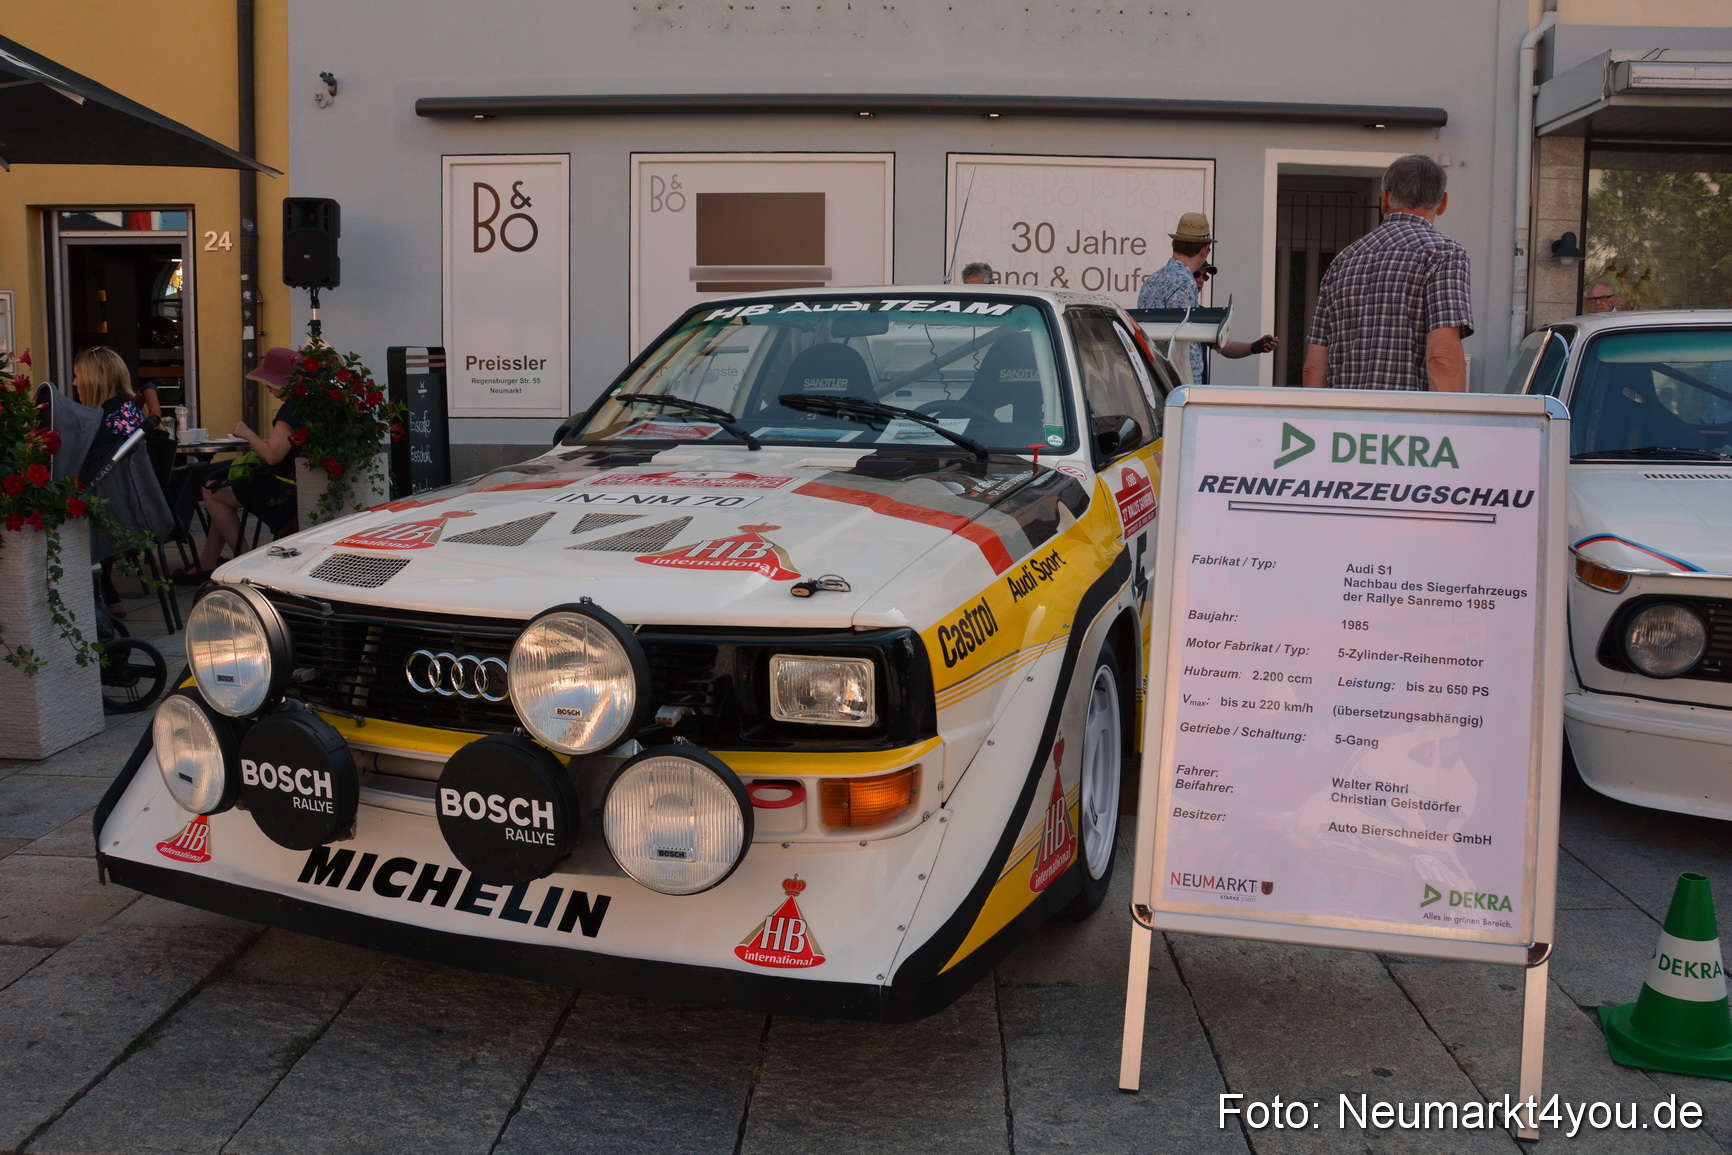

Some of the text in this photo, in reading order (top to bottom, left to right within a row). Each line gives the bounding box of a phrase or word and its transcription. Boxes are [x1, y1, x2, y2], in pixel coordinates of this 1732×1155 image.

[204, 231, 233, 251] 24
[1011, 221, 1147, 255] 30 Jahre
[1051, 266, 1070, 289] &
[703, 299, 1014, 322] HB Audi TEAM
[466, 355, 547, 371] Preissler
[471, 378, 518, 387] Regensburger
[803, 378, 848, 388] SANDTLER
[1332, 432, 1459, 469] DEKRA
[554, 493, 745, 507] IN-NM 70
[1198, 475, 1535, 508] RENNFAHRZEUGSCHAU
[357, 523, 442, 541] HB
[683, 540, 775, 559] HB
[652, 556, 779, 577] international
[1191, 555, 1240, 566] Fabrikat
[1251, 558, 1276, 570] Typ:
[1346, 563, 1392, 576] Audi S1
[1006, 549, 1067, 603] Audi Sport
[1344, 577, 1527, 599] Nachbau des Siegerfahrzeugs
[1343, 591, 1495, 610] der Rallye Sanremo 1985
[1188, 610, 1238, 623] Baujahr:
[1341, 620, 1369, 631] 1985
[937, 597, 999, 668] Castrol
[1186, 638, 1220, 651] Motor
[1223, 641, 1273, 653] Fabrikat
[1285, 644, 1310, 657] Typ:
[1338, 648, 1484, 667] 5-Zylinder-Reihenmotor
[1184, 666, 1312, 684] Hubraum: 2.200 ccm
[1338, 677, 1489, 696] Leistung: bis zu 650 PS
[557, 708, 581, 717] BOSCH
[1221, 697, 1238, 708] bis
[1242, 700, 1256, 709] zu
[1260, 700, 1280, 710] 220
[1285, 702, 1313, 713] km/h
[1332, 705, 1483, 728] (übersetzungsabhängig)
[1180, 722, 1230, 736] Getriebe
[1241, 727, 1306, 743] Schaltung:
[1335, 734, 1378, 749] 5-Gang
[241, 759, 333, 799] BOSCH
[1176, 765, 1218, 778] Fahrer:
[1175, 779, 1234, 793] Beifahrer:
[1332, 778, 1408, 793] Walter Röhrl
[293, 797, 334, 814] RALLYE
[440, 787, 555, 830] BOSCH
[1331, 792, 1461, 812] Christian Geistdörfer
[1173, 807, 1226, 821] Besitzer:
[175, 821, 210, 851] HB
[505, 827, 556, 846] RALLYE
[1042, 795, 1067, 862] HB
[1328, 822, 1492, 845] Auto Bierschneider GmbH
[160, 844, 204, 861] international
[658, 850, 685, 858] BOSCH
[1034, 850, 1071, 889] international
[297, 846, 612, 938] MICHELIN
[1170, 872, 1257, 893] NEUMARKT
[1449, 890, 1513, 912] DEKRA
[1423, 912, 1512, 928] Alles im grünen Bereich.
[760, 915, 808, 954] HB
[744, 950, 814, 967] international
[1658, 953, 1722, 979] DEKRA
